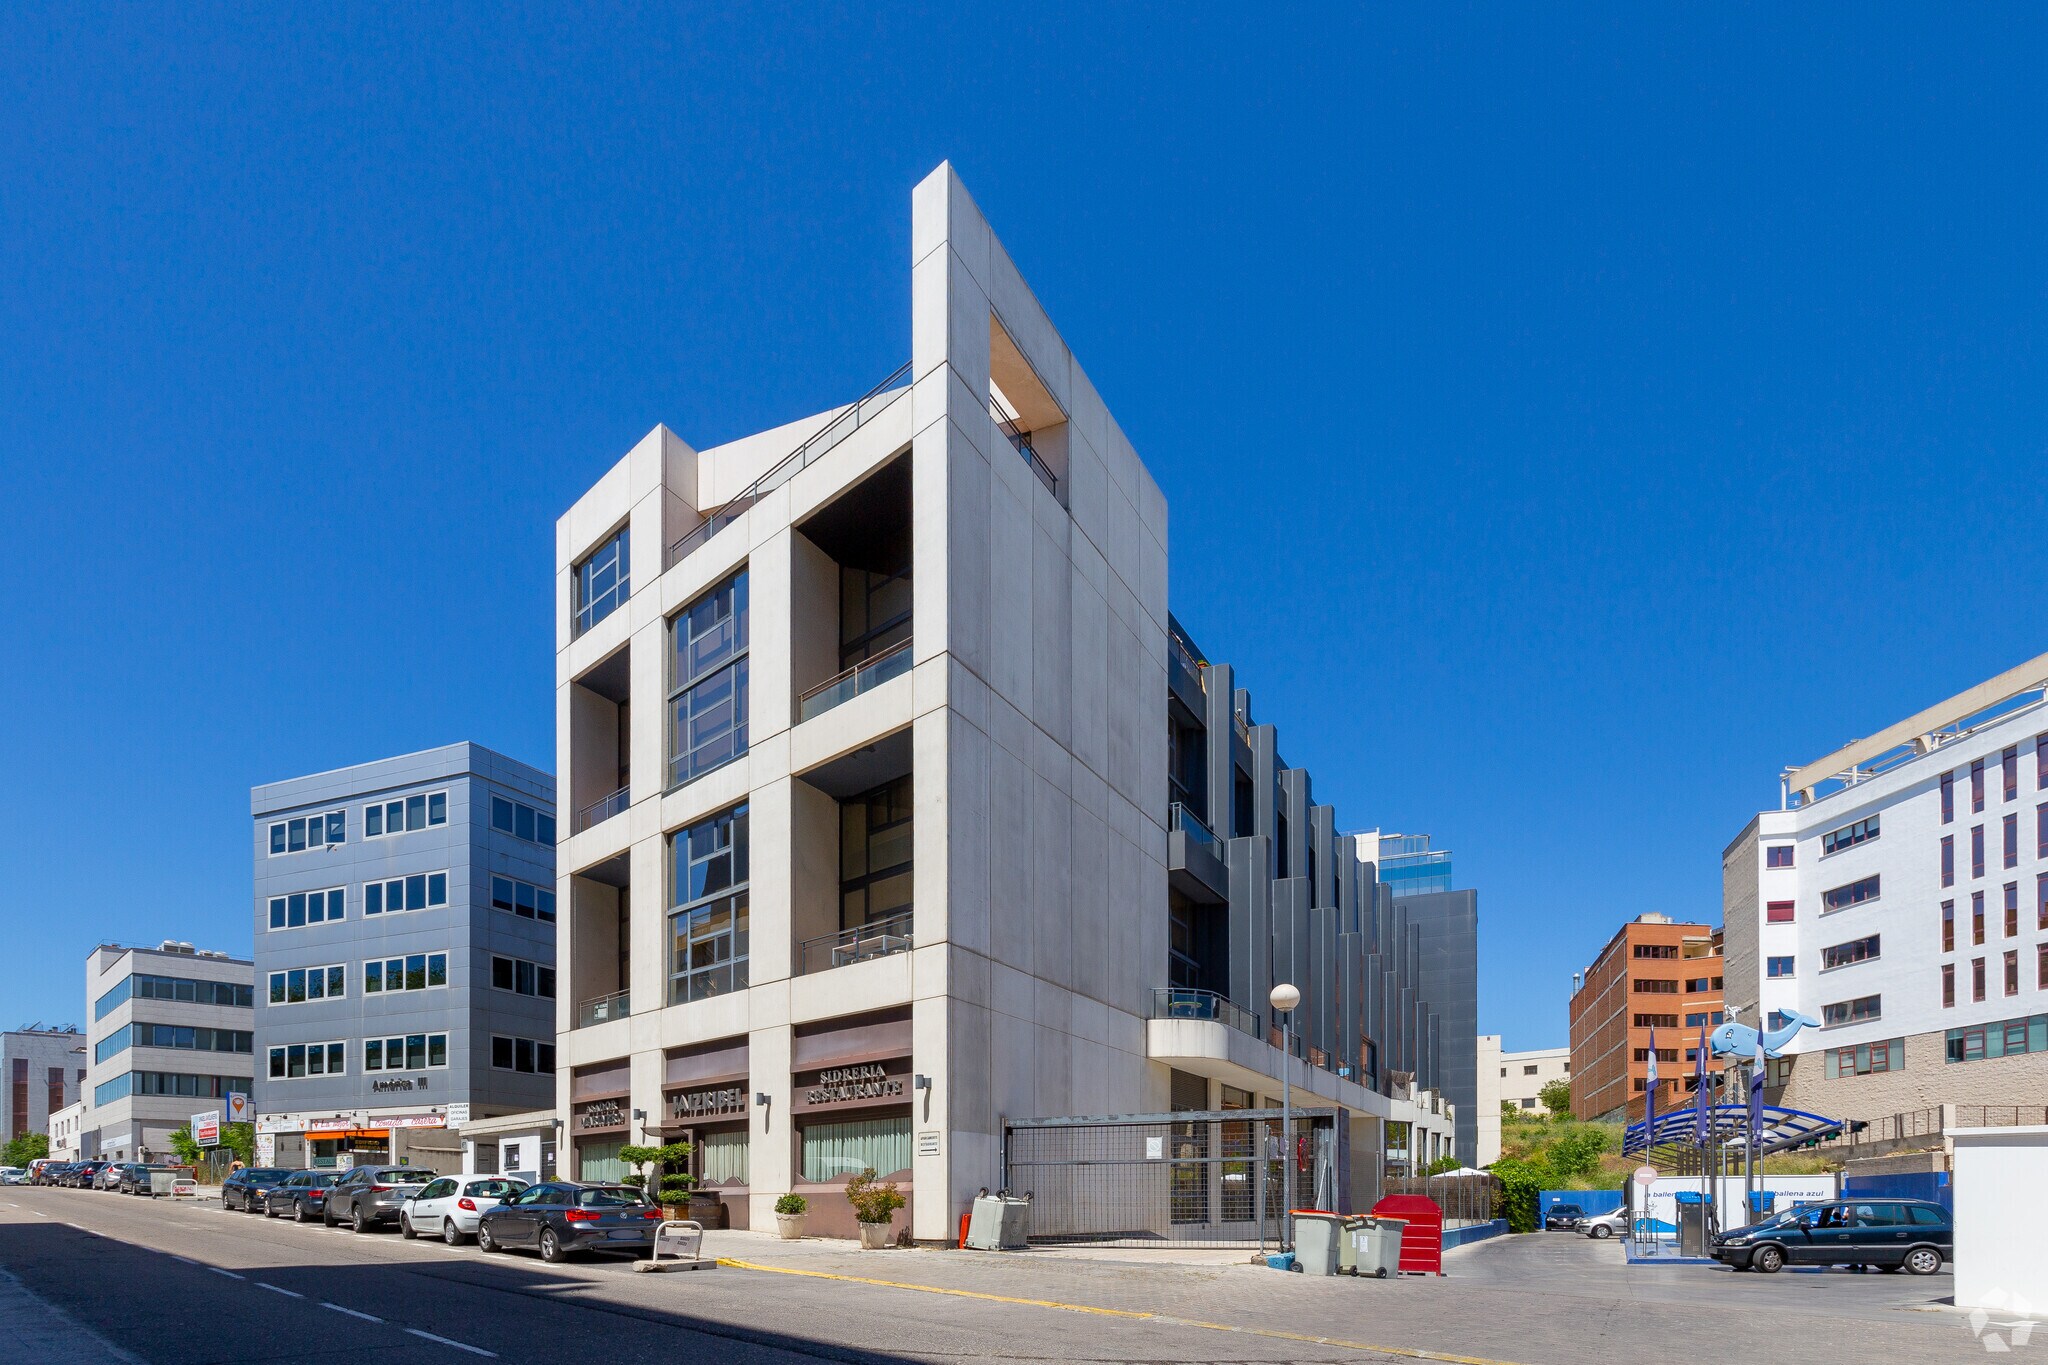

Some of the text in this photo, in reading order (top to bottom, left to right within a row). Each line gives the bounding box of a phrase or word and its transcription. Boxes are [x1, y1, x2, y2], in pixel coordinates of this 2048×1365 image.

[820, 1064, 886, 1084] SIDRERIA
[672, 1087, 745, 1114] JAIZKIBEL
[806, 1080, 903, 1104] RESTAURANTE
